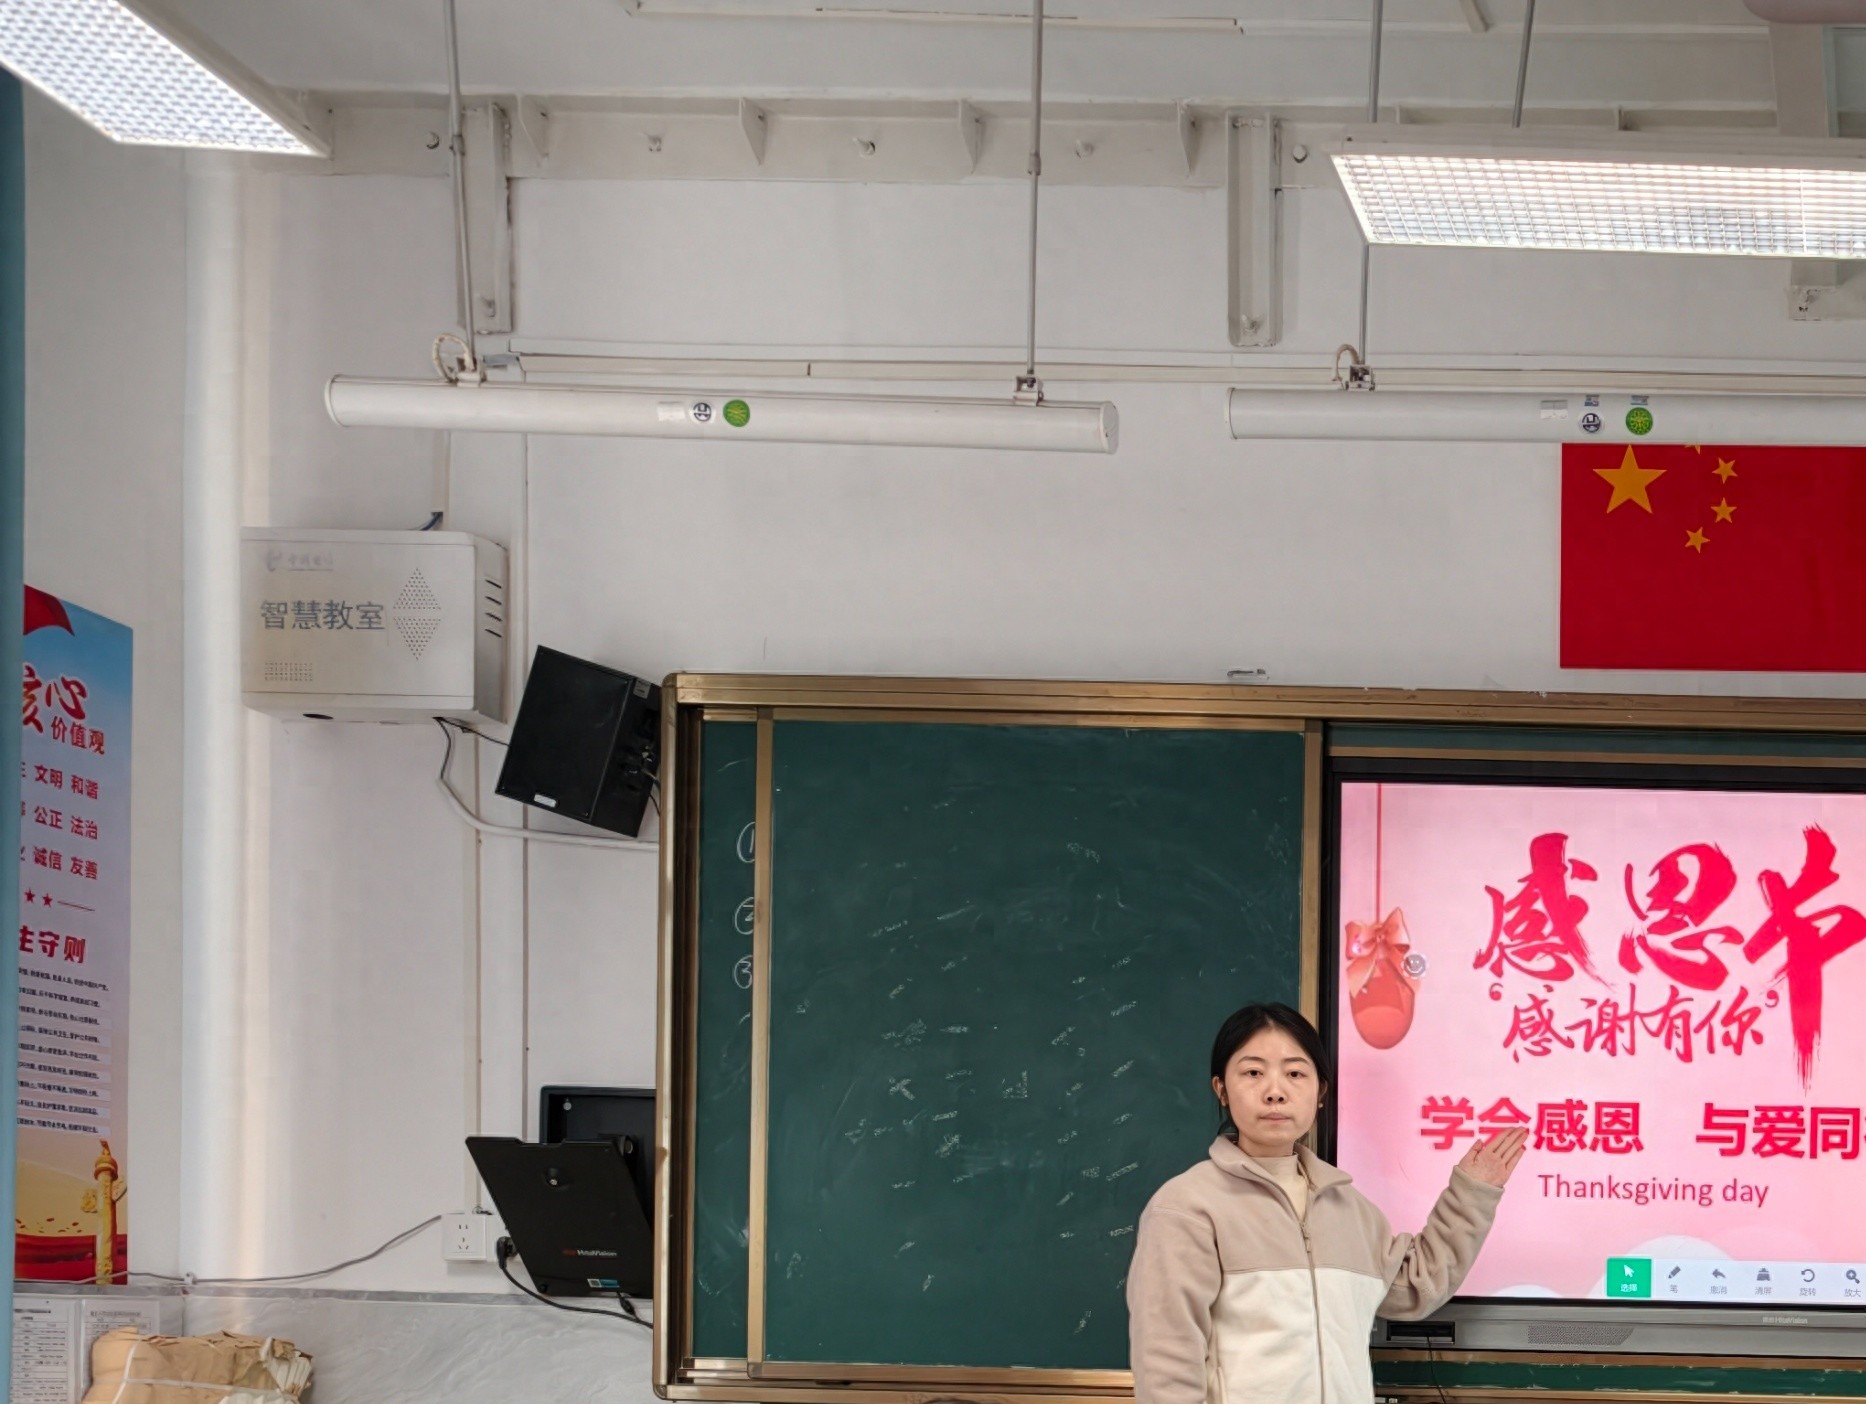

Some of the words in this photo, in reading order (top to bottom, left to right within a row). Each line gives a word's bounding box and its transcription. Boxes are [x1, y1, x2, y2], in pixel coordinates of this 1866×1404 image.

[260, 599, 386, 631] 智慧教室
[51, 714, 105, 755] 价值观
[34, 764, 63, 789] 文明
[71, 774, 98, 800] 和谐
[34, 805, 63, 830] 公正
[71, 815, 98, 840] 法治
[33, 845, 62, 871] 诚信
[71, 856, 98, 880] 友善
[1538, 1173, 1713, 1208] Thanksgiving
[1722, 1176, 1770, 1208] day
[1844, 1288, 1862, 1298] 放大
